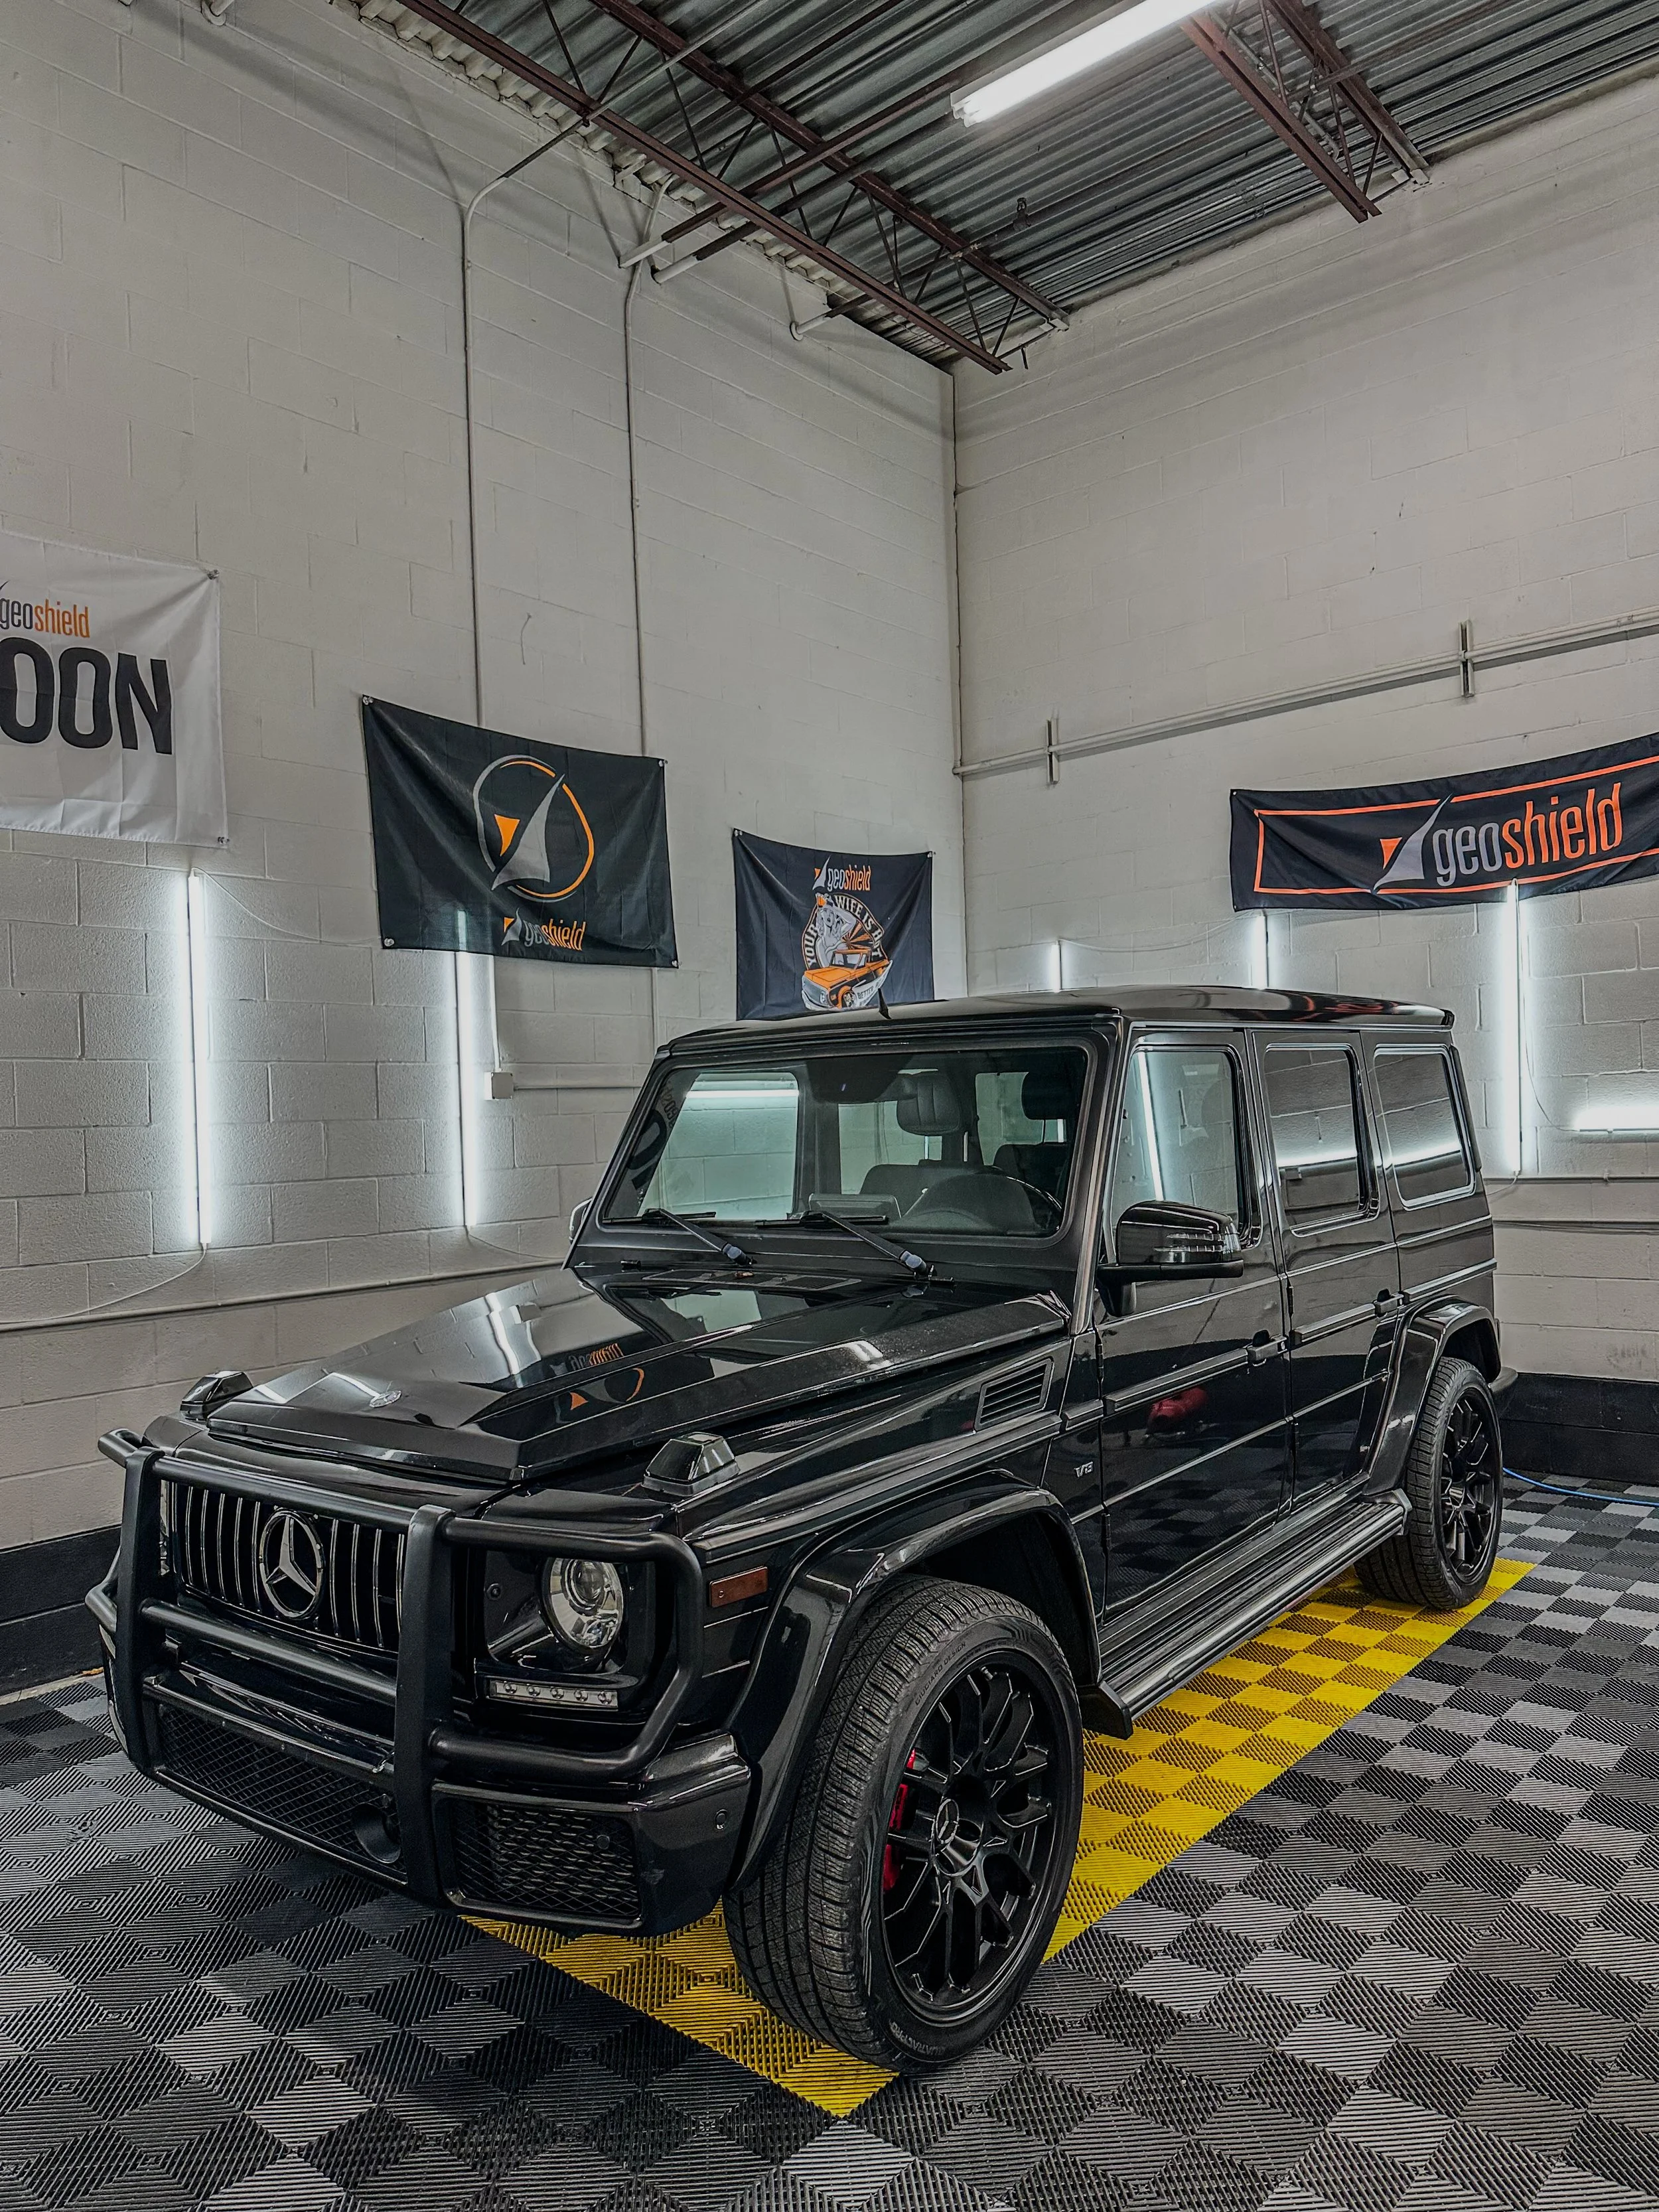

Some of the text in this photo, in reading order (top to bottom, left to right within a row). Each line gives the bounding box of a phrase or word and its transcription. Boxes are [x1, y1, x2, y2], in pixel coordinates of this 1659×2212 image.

[0, 598, 90, 638] geoshield
[1432, 782, 1623, 887] geoshield
[827, 864, 871, 892] geoshield
[805, 923, 818, 968] YOUR
[834, 895, 863, 917] WIFE
[863, 910, 877, 930] IS
